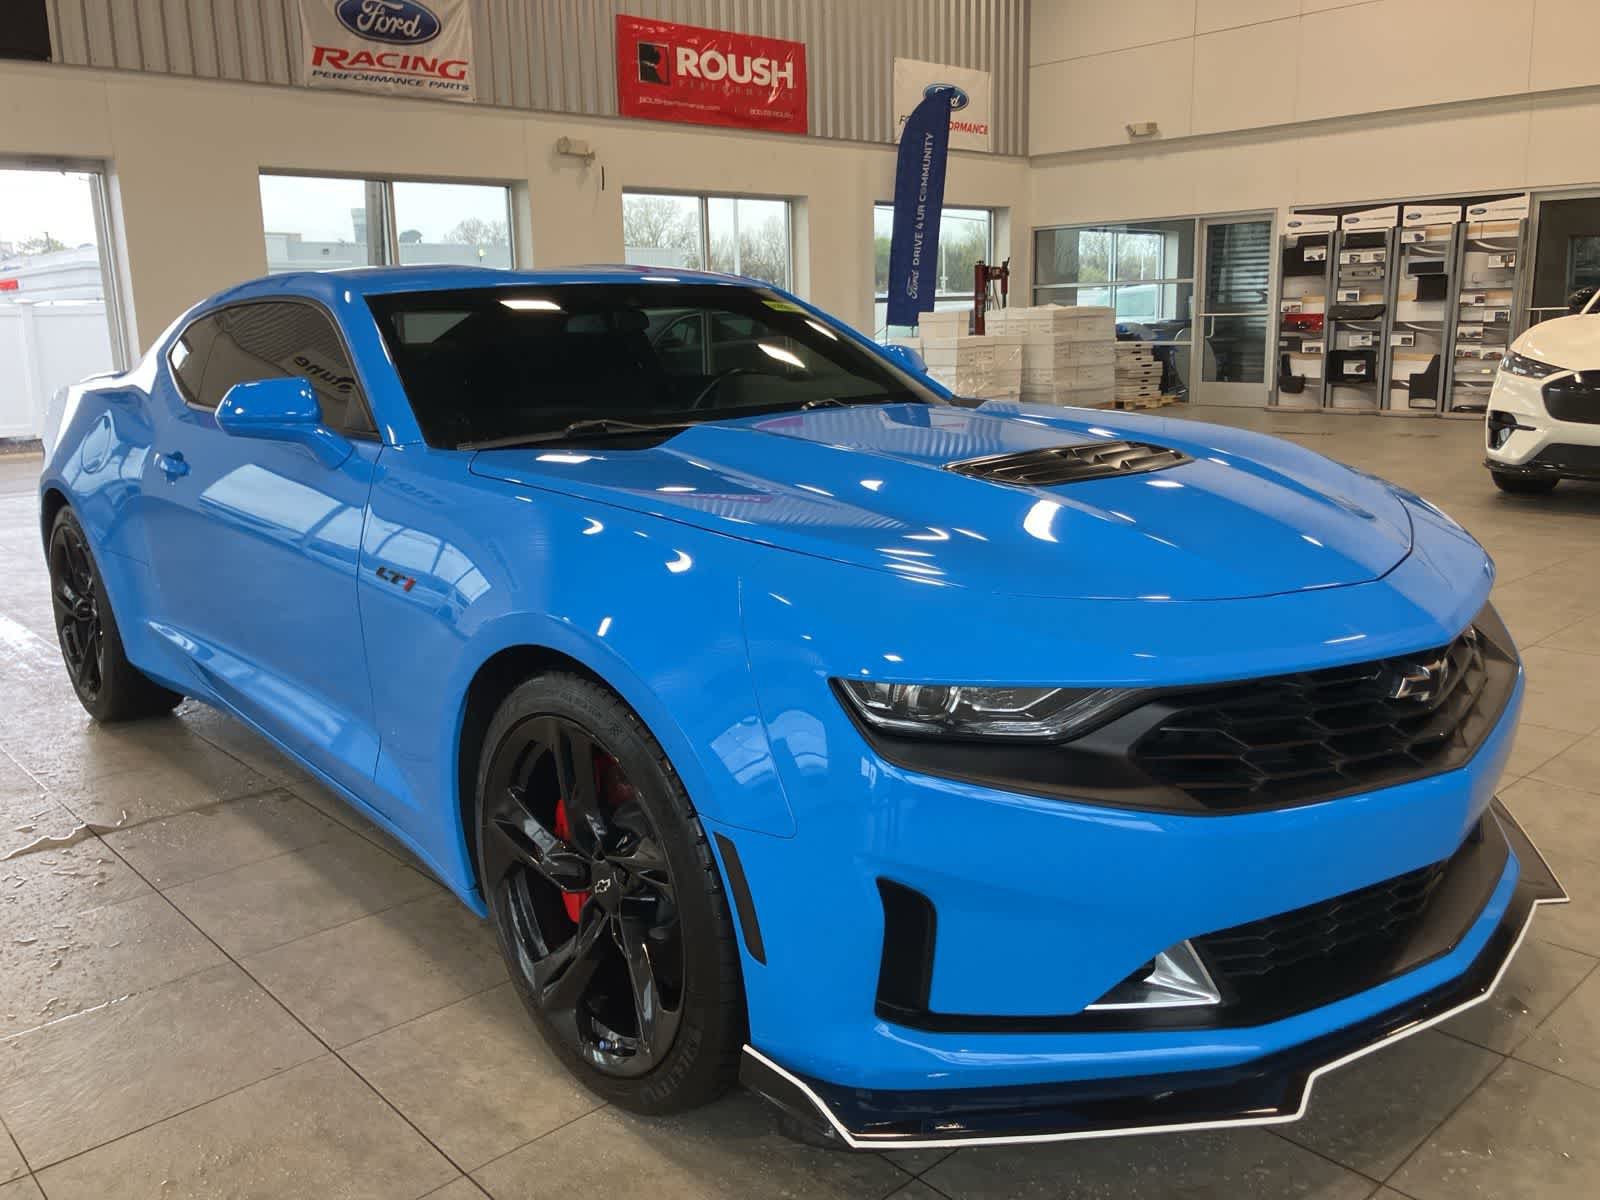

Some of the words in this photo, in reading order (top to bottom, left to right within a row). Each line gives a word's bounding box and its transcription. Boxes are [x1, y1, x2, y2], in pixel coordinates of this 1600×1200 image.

[357, 0, 421, 37] Ford
[312, 45, 469, 80] RACING
[676, 46, 794, 89] ROUSH
[312, 70, 425, 86] PERFORMANCE
[429, 81, 469, 92] PARTS
[949, 121, 988, 135] ORMANCE
[919, 132, 934, 202] COMMUNITY
[916, 222, 924, 230] 4
[917, 205, 926, 221] UR
[912, 232, 923, 265] DRIVE
[906, 270, 919, 299] Ford
